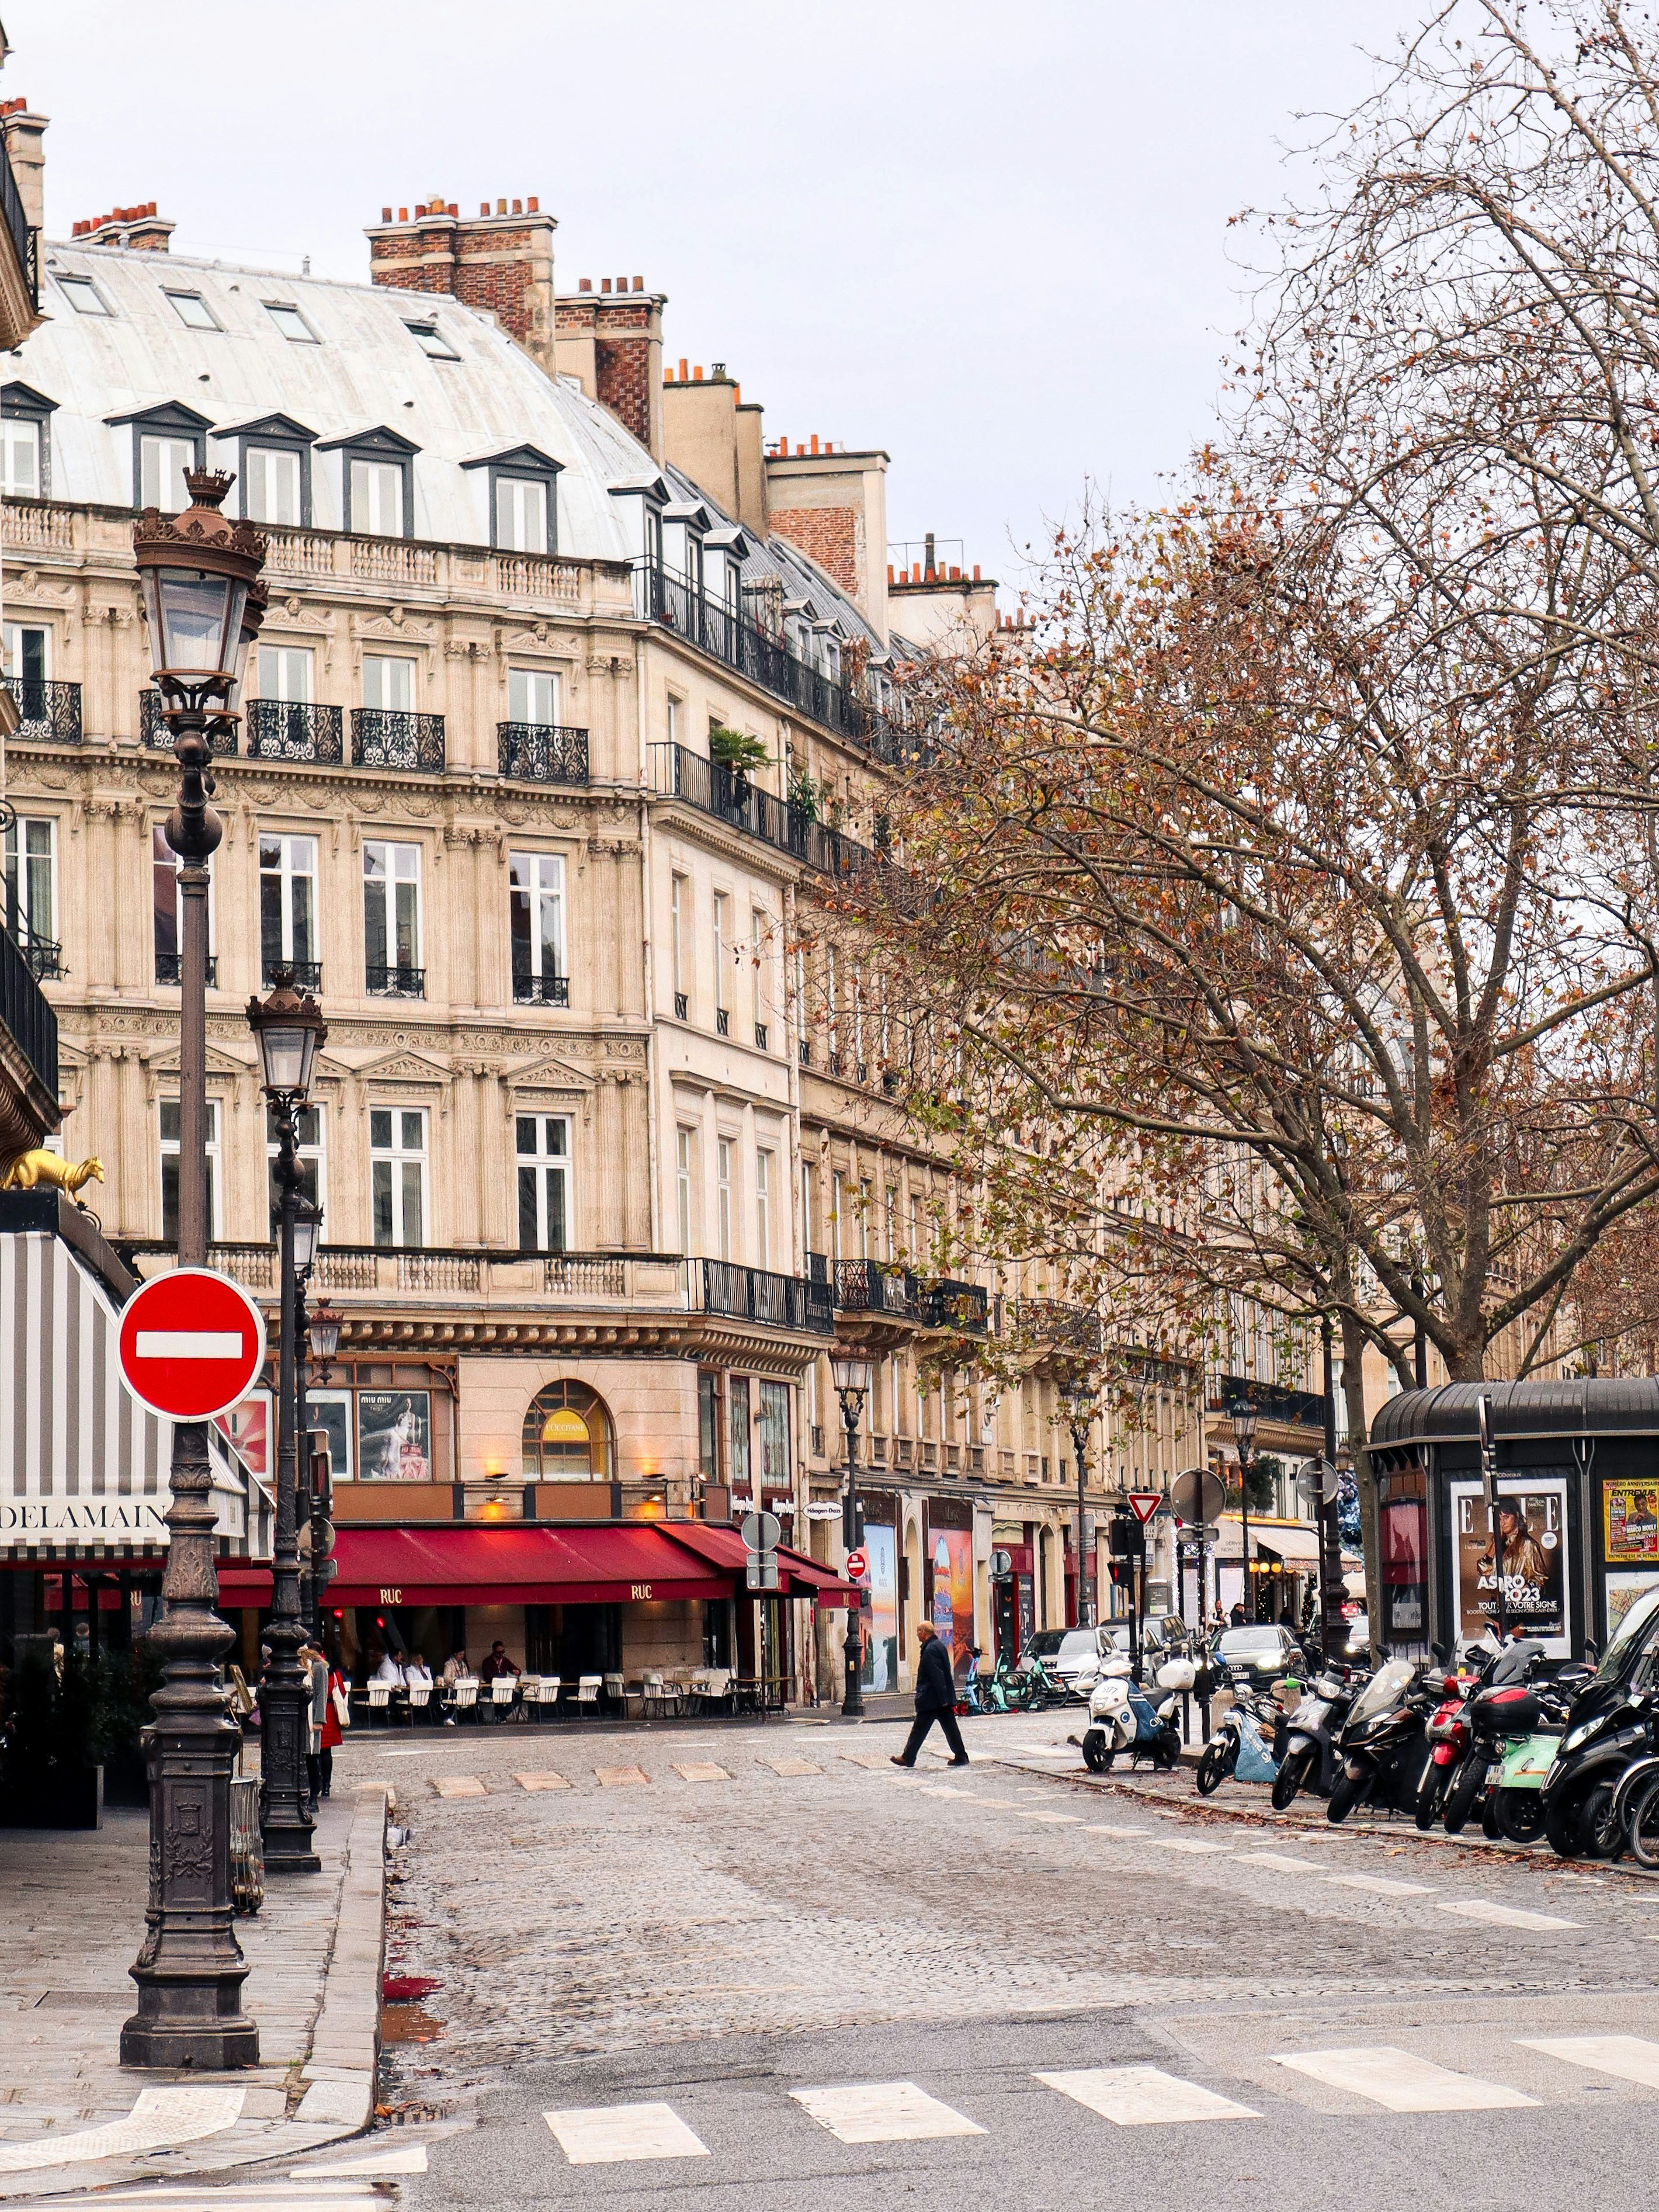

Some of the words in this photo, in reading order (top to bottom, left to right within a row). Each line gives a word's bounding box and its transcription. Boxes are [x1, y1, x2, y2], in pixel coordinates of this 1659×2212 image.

[0, 1505, 166, 1528] DELAMAIN
[1477, 1575, 1525, 1589] ASRO
[380, 1589, 402, 1604] RUC
[631, 1584, 652, 1599] RUC
[1505, 1587, 1540, 1602] 2023
[1478, 1601, 1496, 1610] TOUT
